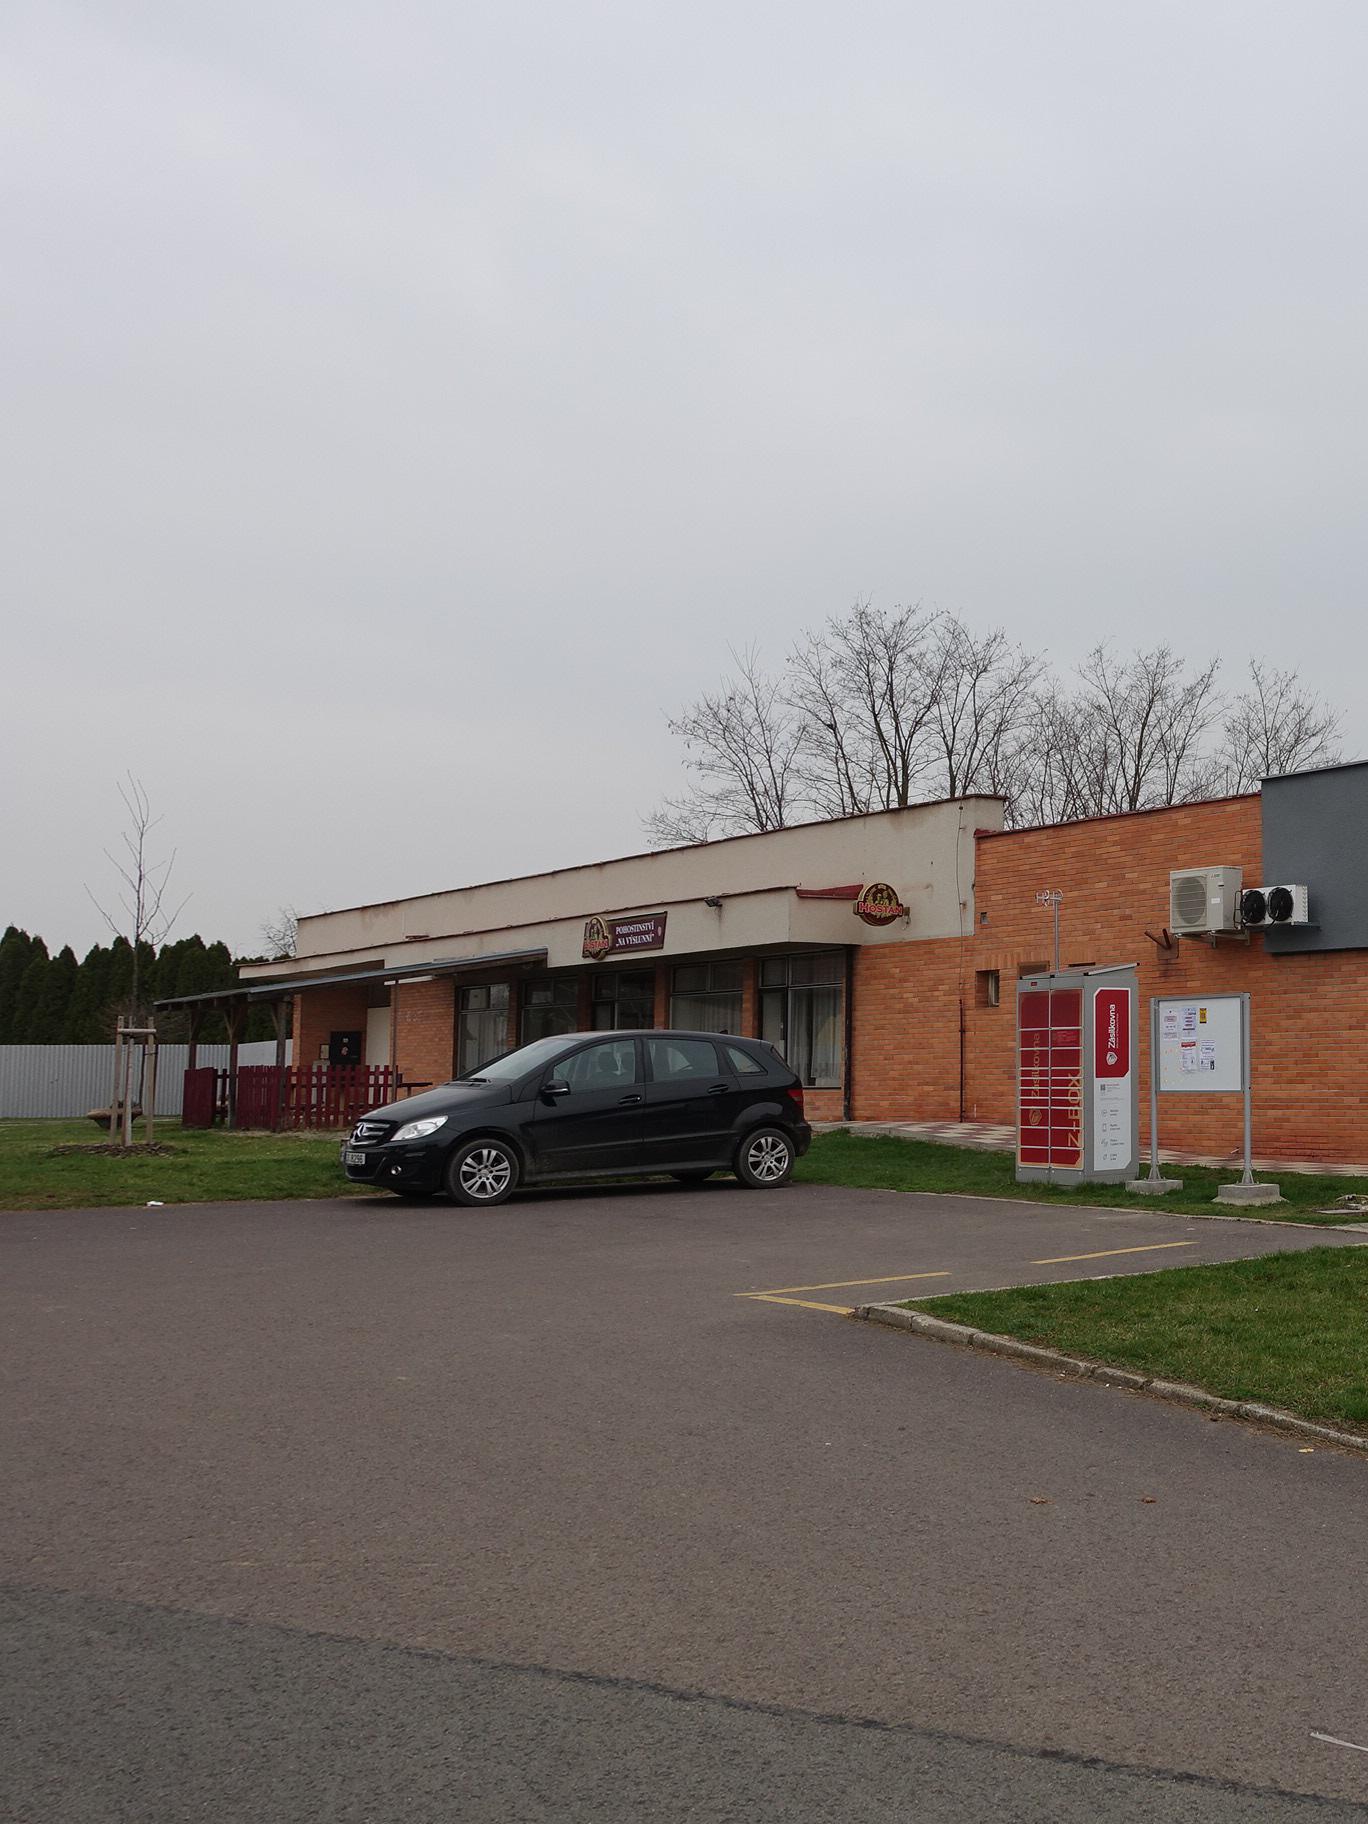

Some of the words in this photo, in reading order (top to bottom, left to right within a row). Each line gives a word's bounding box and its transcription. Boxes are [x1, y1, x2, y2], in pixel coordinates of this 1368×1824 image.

[858, 902, 903, 915] HOSTAN
[1108, 1004, 1116, 1049] Zásilkovna
[1068, 1073, 1080, 1147] Z-BOX
